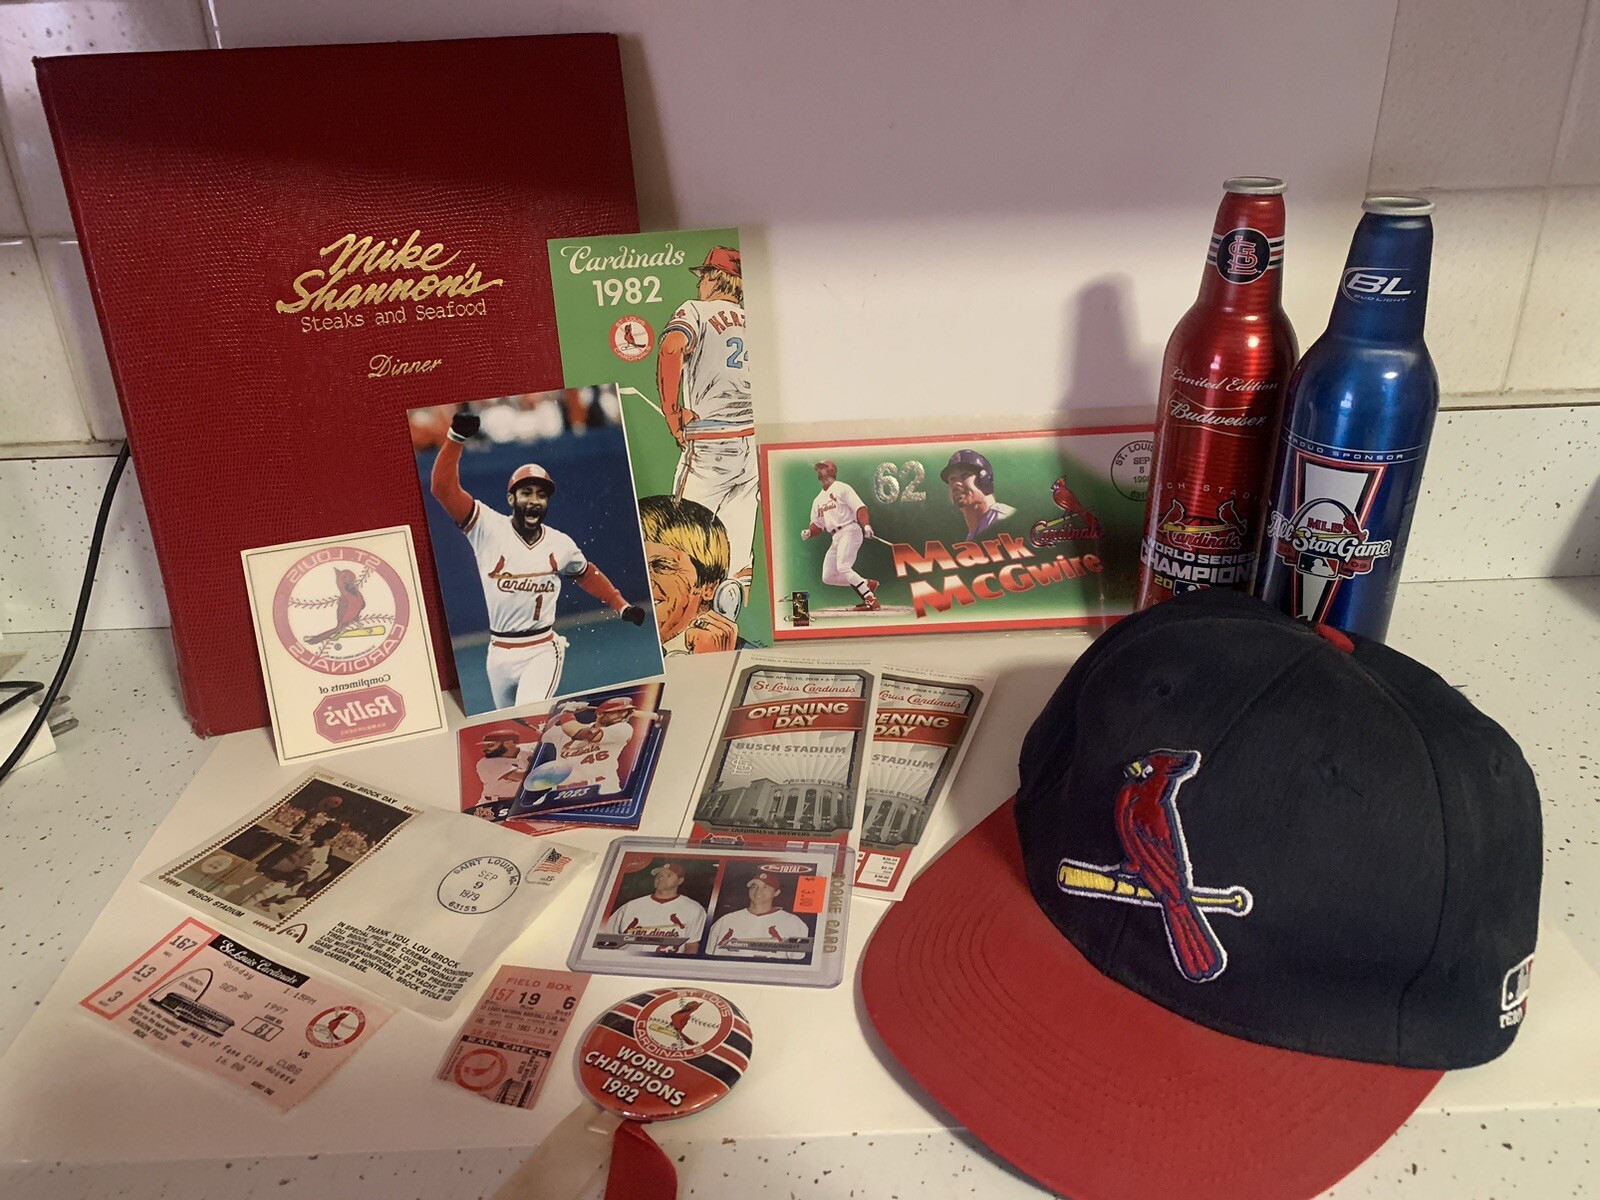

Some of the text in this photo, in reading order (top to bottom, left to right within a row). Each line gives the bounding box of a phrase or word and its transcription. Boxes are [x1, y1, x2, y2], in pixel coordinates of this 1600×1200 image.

[319, 230, 461, 276] Mike
[560, 243, 685, 274] Cardinals
[276, 263, 503, 313] Shannon's
[592, 276, 662, 306] 1982
[1346, 272, 1412, 295] BL
[301, 299, 486, 332] Steaks and Seafood
[368, 354, 442, 378] Dinner
[1170, 366, 1278, 392] Limited Edition
[1169, 399, 1268, 427] Budweiser
[1115, 453, 1128, 466] ST.
[1133, 456, 1150, 465] SEP
[1332, 451, 1404, 460] SPONSOR
[875, 460, 927, 503] 62
[1307, 517, 1344, 533] MLB
[1143, 538, 1255, 565] WORLD SERIES
[1167, 531, 1242, 550] Cardinals
[891, 532, 1036, 578] Mark
[497, 572, 555, 593] Cardinals
[909, 552, 1104, 619] McGwire
[533, 594, 543, 621] 1
[802, 683, 856, 695] Cardinals
[748, 702, 850, 719] OPENING
[907, 694, 961, 708] Cardinals
[774, 715, 819, 729] DAY
[874, 725, 917, 737] DAY
[581, 750, 609, 765] 46
[735, 742, 848, 755] BUSCH STADIUM
[872, 753, 934, 769] STADIUM
[342, 780, 398, 804] LOU BROCK DAY
[731, 827, 766, 835] CARDINALS
[453, 858, 482, 875] SAINT
[478, 869, 498, 881] SEP
[780, 865, 802, 873] TOTAL
[459, 889, 480, 902] 1979
[473, 881, 484, 890] 9
[829, 872, 846, 914] ROOKIE
[187, 888, 246, 917] BUSCH STADIUM
[448, 901, 477, 912] 63155
[169, 935, 198, 952] 167
[345, 925, 369, 937] SPECIAL
[400, 947, 442, 970] CEREMONIES
[366, 925, 391, 937] THANK
[412, 942, 431, 954] LOU
[431, 952, 460, 969] BROCK
[823, 920, 840, 953] CARD
[320, 935, 334, 944] LOU
[334, 941, 350, 949] WITH
[354, 948, 397, 971] MAGNIFICENT
[324, 951, 350, 964] CAREER
[327, 931, 346, 941] TIRED
[345, 939, 374, 951] UNIFORM
[373, 949, 402, 965] NUMBER
[412, 969, 427, 978] AND
[332, 926, 346, 935] LOU
[372, 941, 386, 949] THE
[399, 953, 419, 967] LOUIS
[421, 965, 457, 982] CARDINALS
[134, 964, 157, 978] 13
[223, 960, 255, 980] Sunday
[256, 959, 298, 984] Cardinals
[314, 939, 334, 950] GAME
[332, 947, 360, 960] AGAINST
[396, 976, 421, 992] BROCK
[420, 989, 442, 1000] STOLE
[219, 982, 238, 993] SEP
[506, 977, 573, 991] FIELD BOX
[107, 991, 124, 1003] 3
[264, 1002, 288, 1014] 1997
[490, 988, 576, 1010] 157 19 6
[702, 993, 731, 1018] LOUIS
[636, 1020, 705, 1059] CARDINALS
[277, 1058, 303, 1075] CUBS
[617, 1045, 675, 1080] WORLD
[585, 1051, 687, 1107] CHAMPIONS
[601, 1077, 640, 1104] 1982
